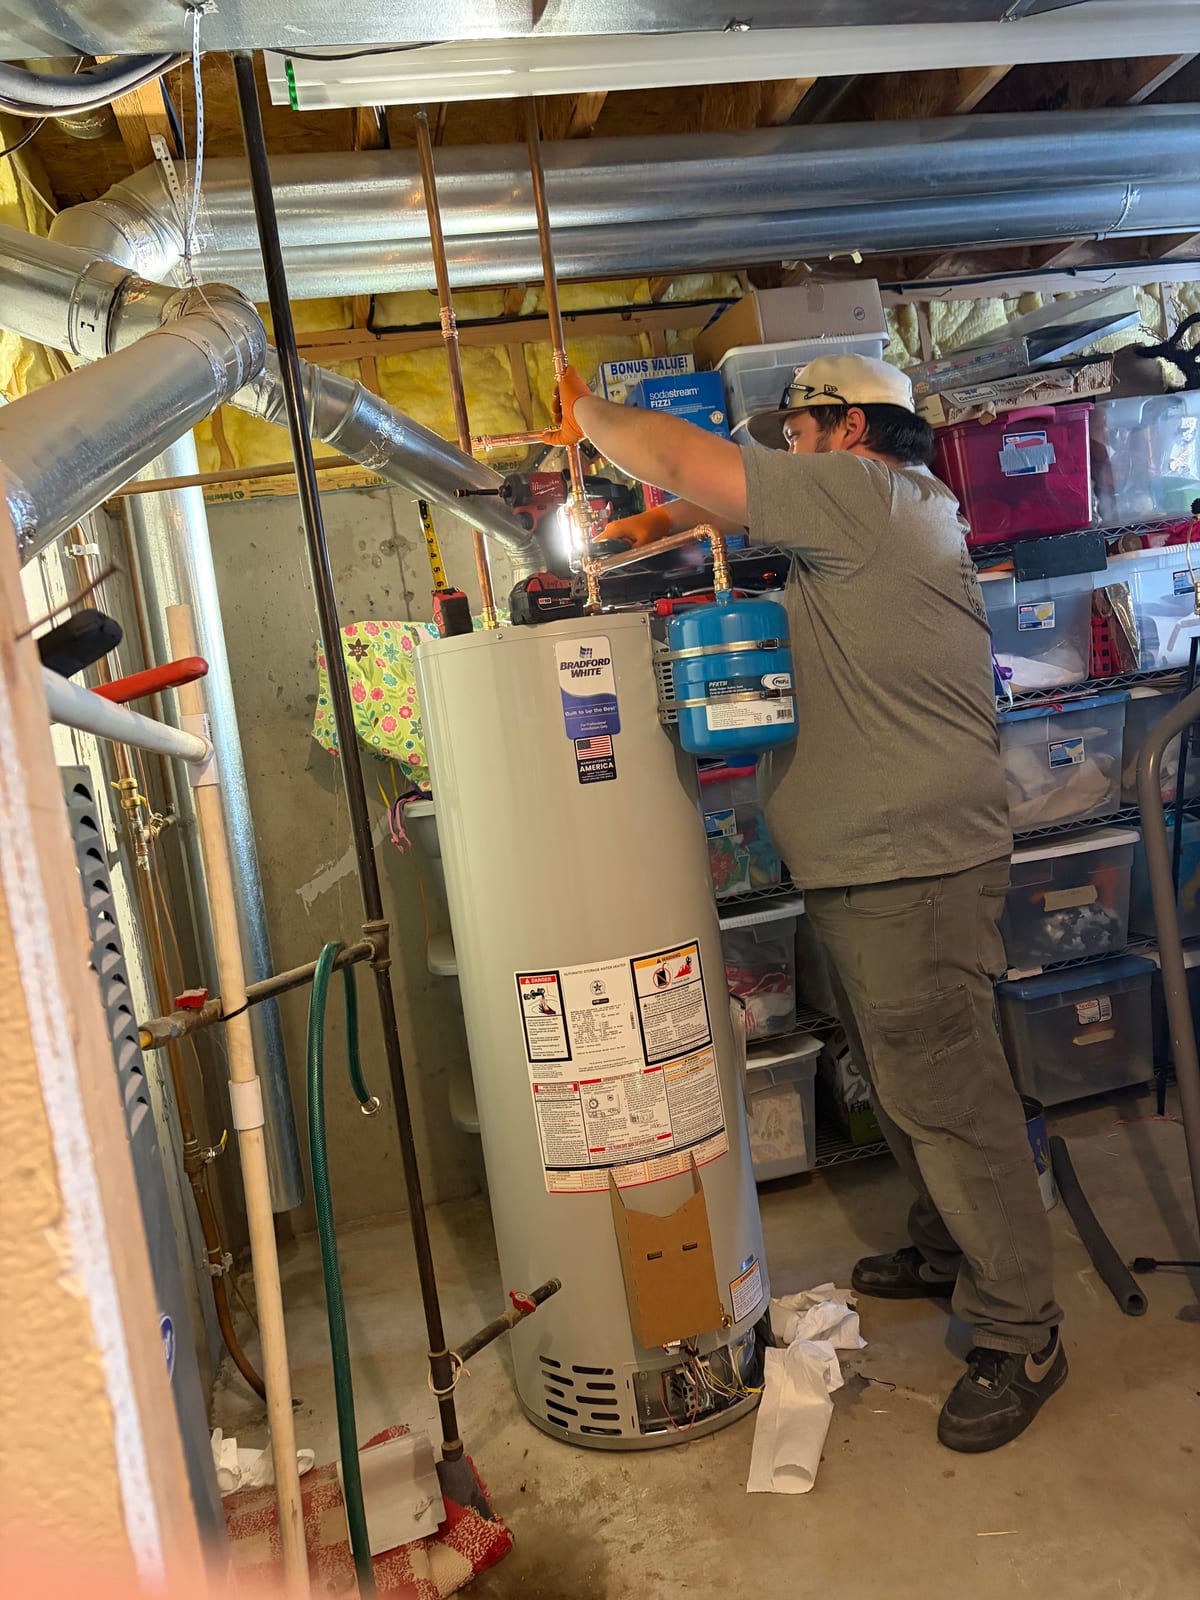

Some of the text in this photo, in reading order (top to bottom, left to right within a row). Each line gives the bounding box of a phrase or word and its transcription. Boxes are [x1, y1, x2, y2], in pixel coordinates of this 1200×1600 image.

[610, 356, 688, 376] BONUS VALUE!
[649, 387, 698, 400] sodastream
[650, 400, 671, 408] FIZZI
[560, 657, 611, 671] BRADFORD
[571, 667, 602, 678] WHITE
[579, 763, 614, 773] AMERICA
